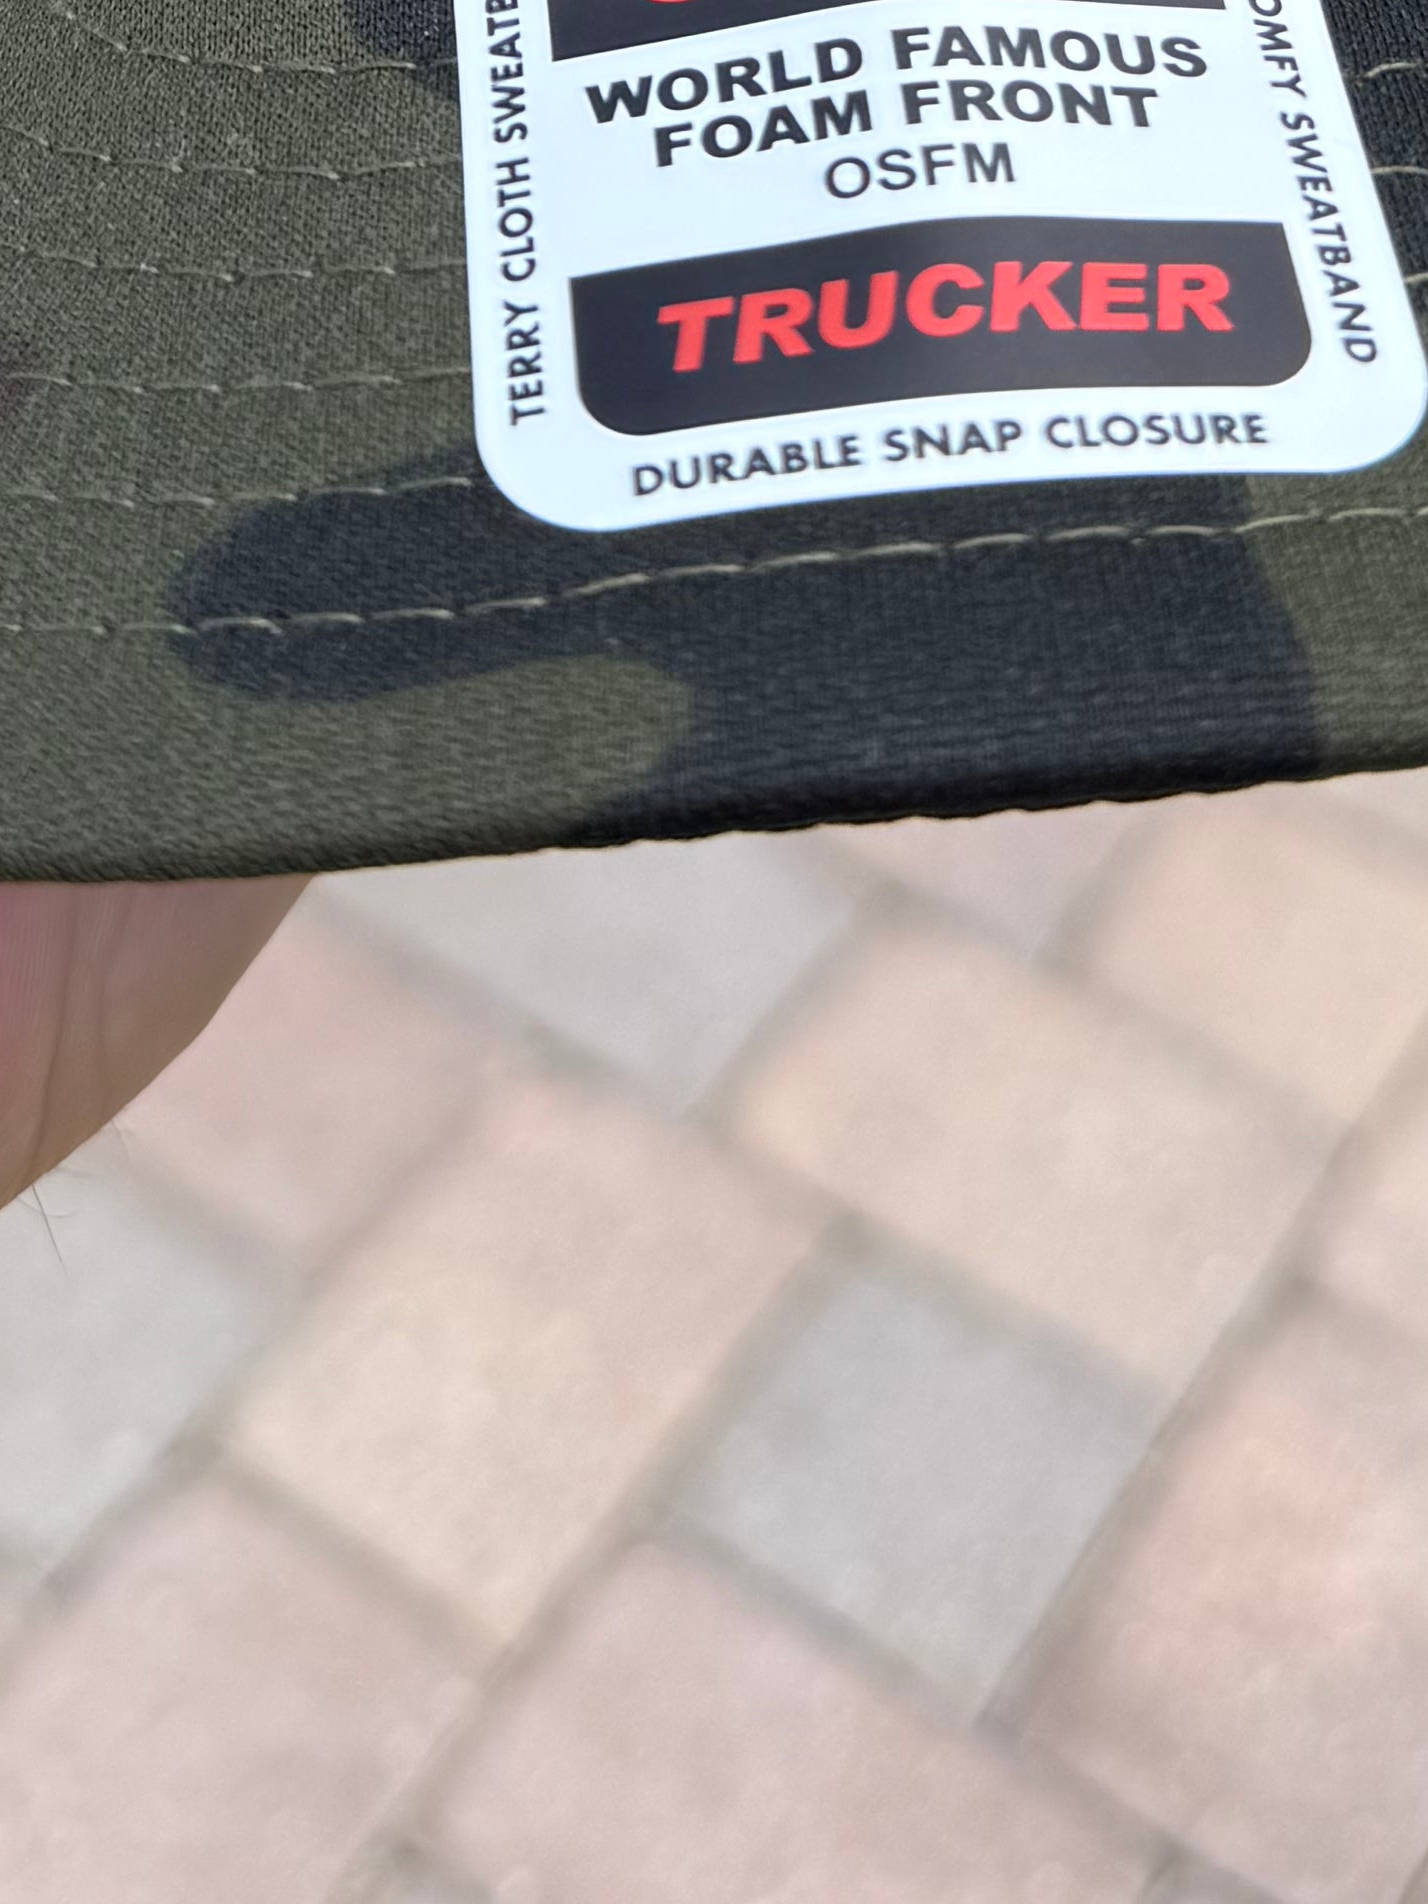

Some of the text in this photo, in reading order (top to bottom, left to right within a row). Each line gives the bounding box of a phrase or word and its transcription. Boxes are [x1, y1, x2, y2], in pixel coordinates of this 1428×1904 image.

[584, 25, 1208, 125] WORLD FAMOUS
[654, 80, 1159, 168] FOAM FRONT
[495, 156, 537, 283] CLOTH
[825, 143, 1015, 199] OSFM
[1279, 111, 1378, 364] SWEATBAND
[504, 302, 546, 427] TERRY
[656, 260, 1234, 374] TRUCKER
[633, 414, 1267, 497] DURABLE SNAP CLOSURE
